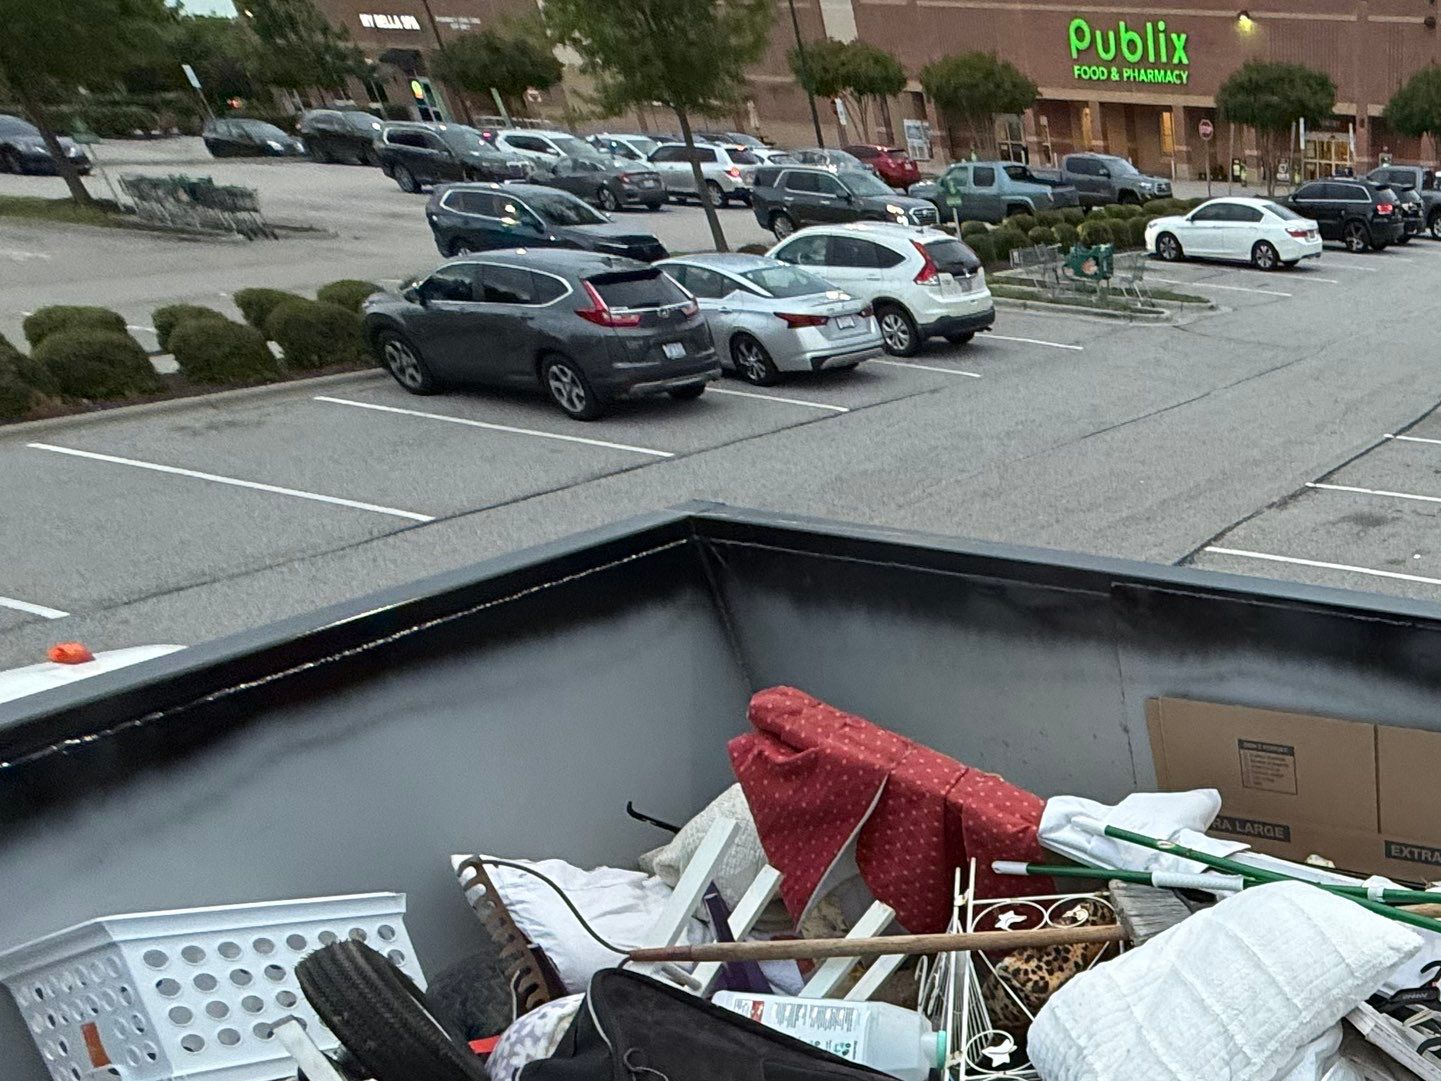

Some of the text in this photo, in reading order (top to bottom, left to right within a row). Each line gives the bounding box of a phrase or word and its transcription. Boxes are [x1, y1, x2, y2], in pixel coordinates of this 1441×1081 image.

[400, 15, 420, 31] SPA
[1068, 17, 1189, 65] Publix
[1073, 65, 1189, 85] FOOD & PHARMACY
[1235, 822, 1285, 840] LARGE
